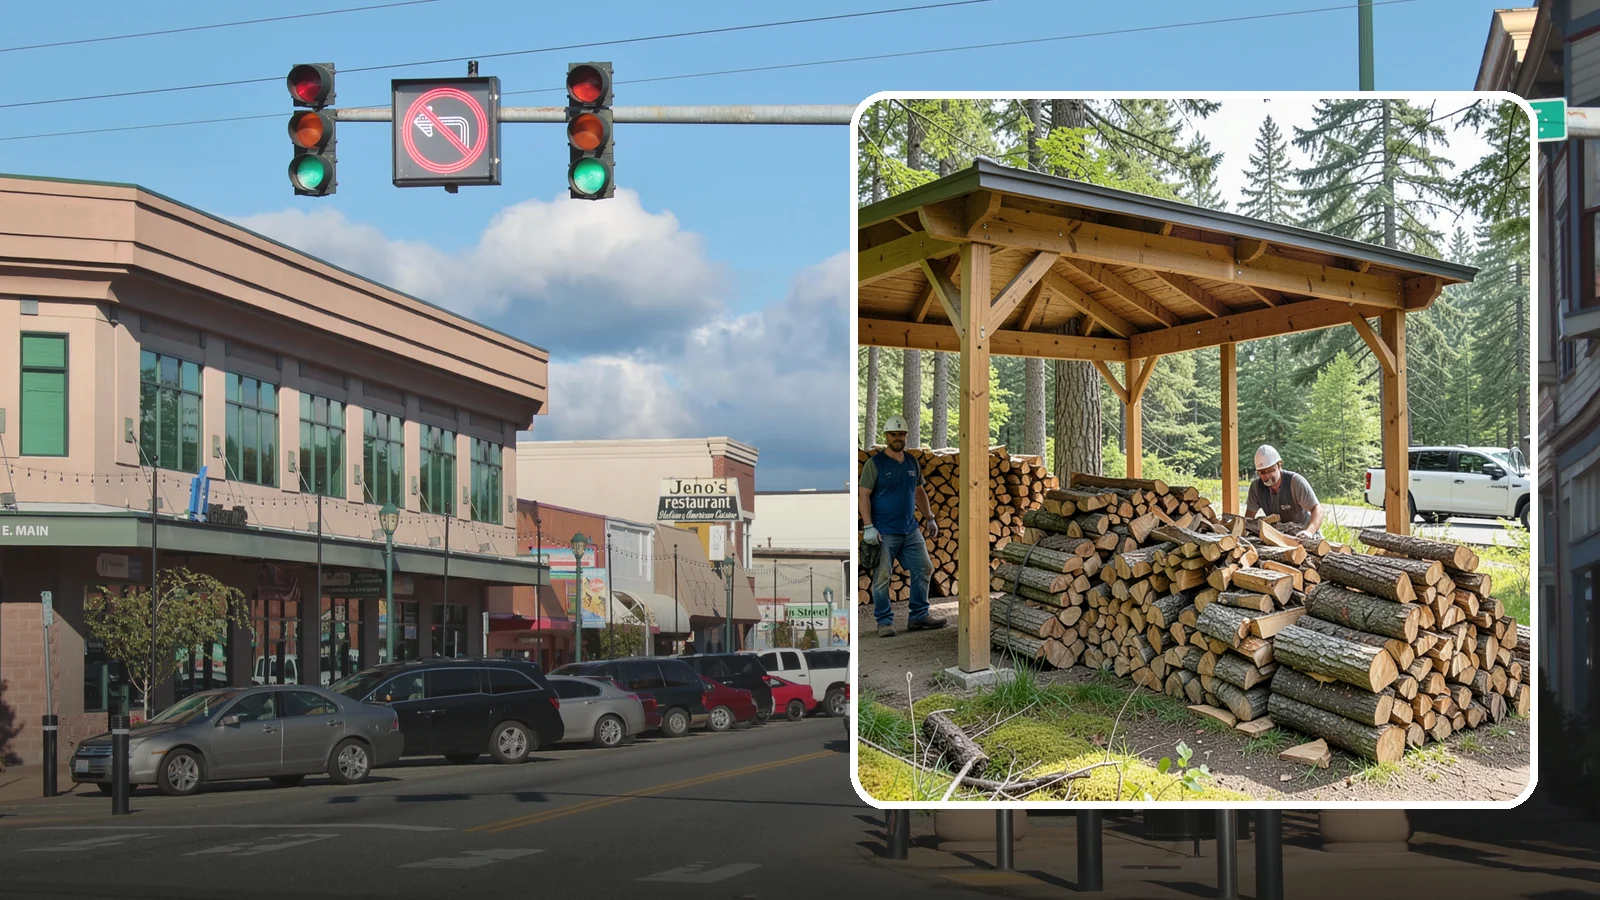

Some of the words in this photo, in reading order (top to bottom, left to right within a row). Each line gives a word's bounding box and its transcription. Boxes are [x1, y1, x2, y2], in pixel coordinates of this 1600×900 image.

[670, 480, 727, 494] Jeno's
[665, 496, 731, 509] restaurant
[659, 510, 682, 519] Italian
[686, 510, 714, 519] American
[715, 510, 737, 519] Cuisine
[2, 525, 13, 536] E.
[15, 525, 49, 536] MAIN
[797, 608, 828, 616] Street
